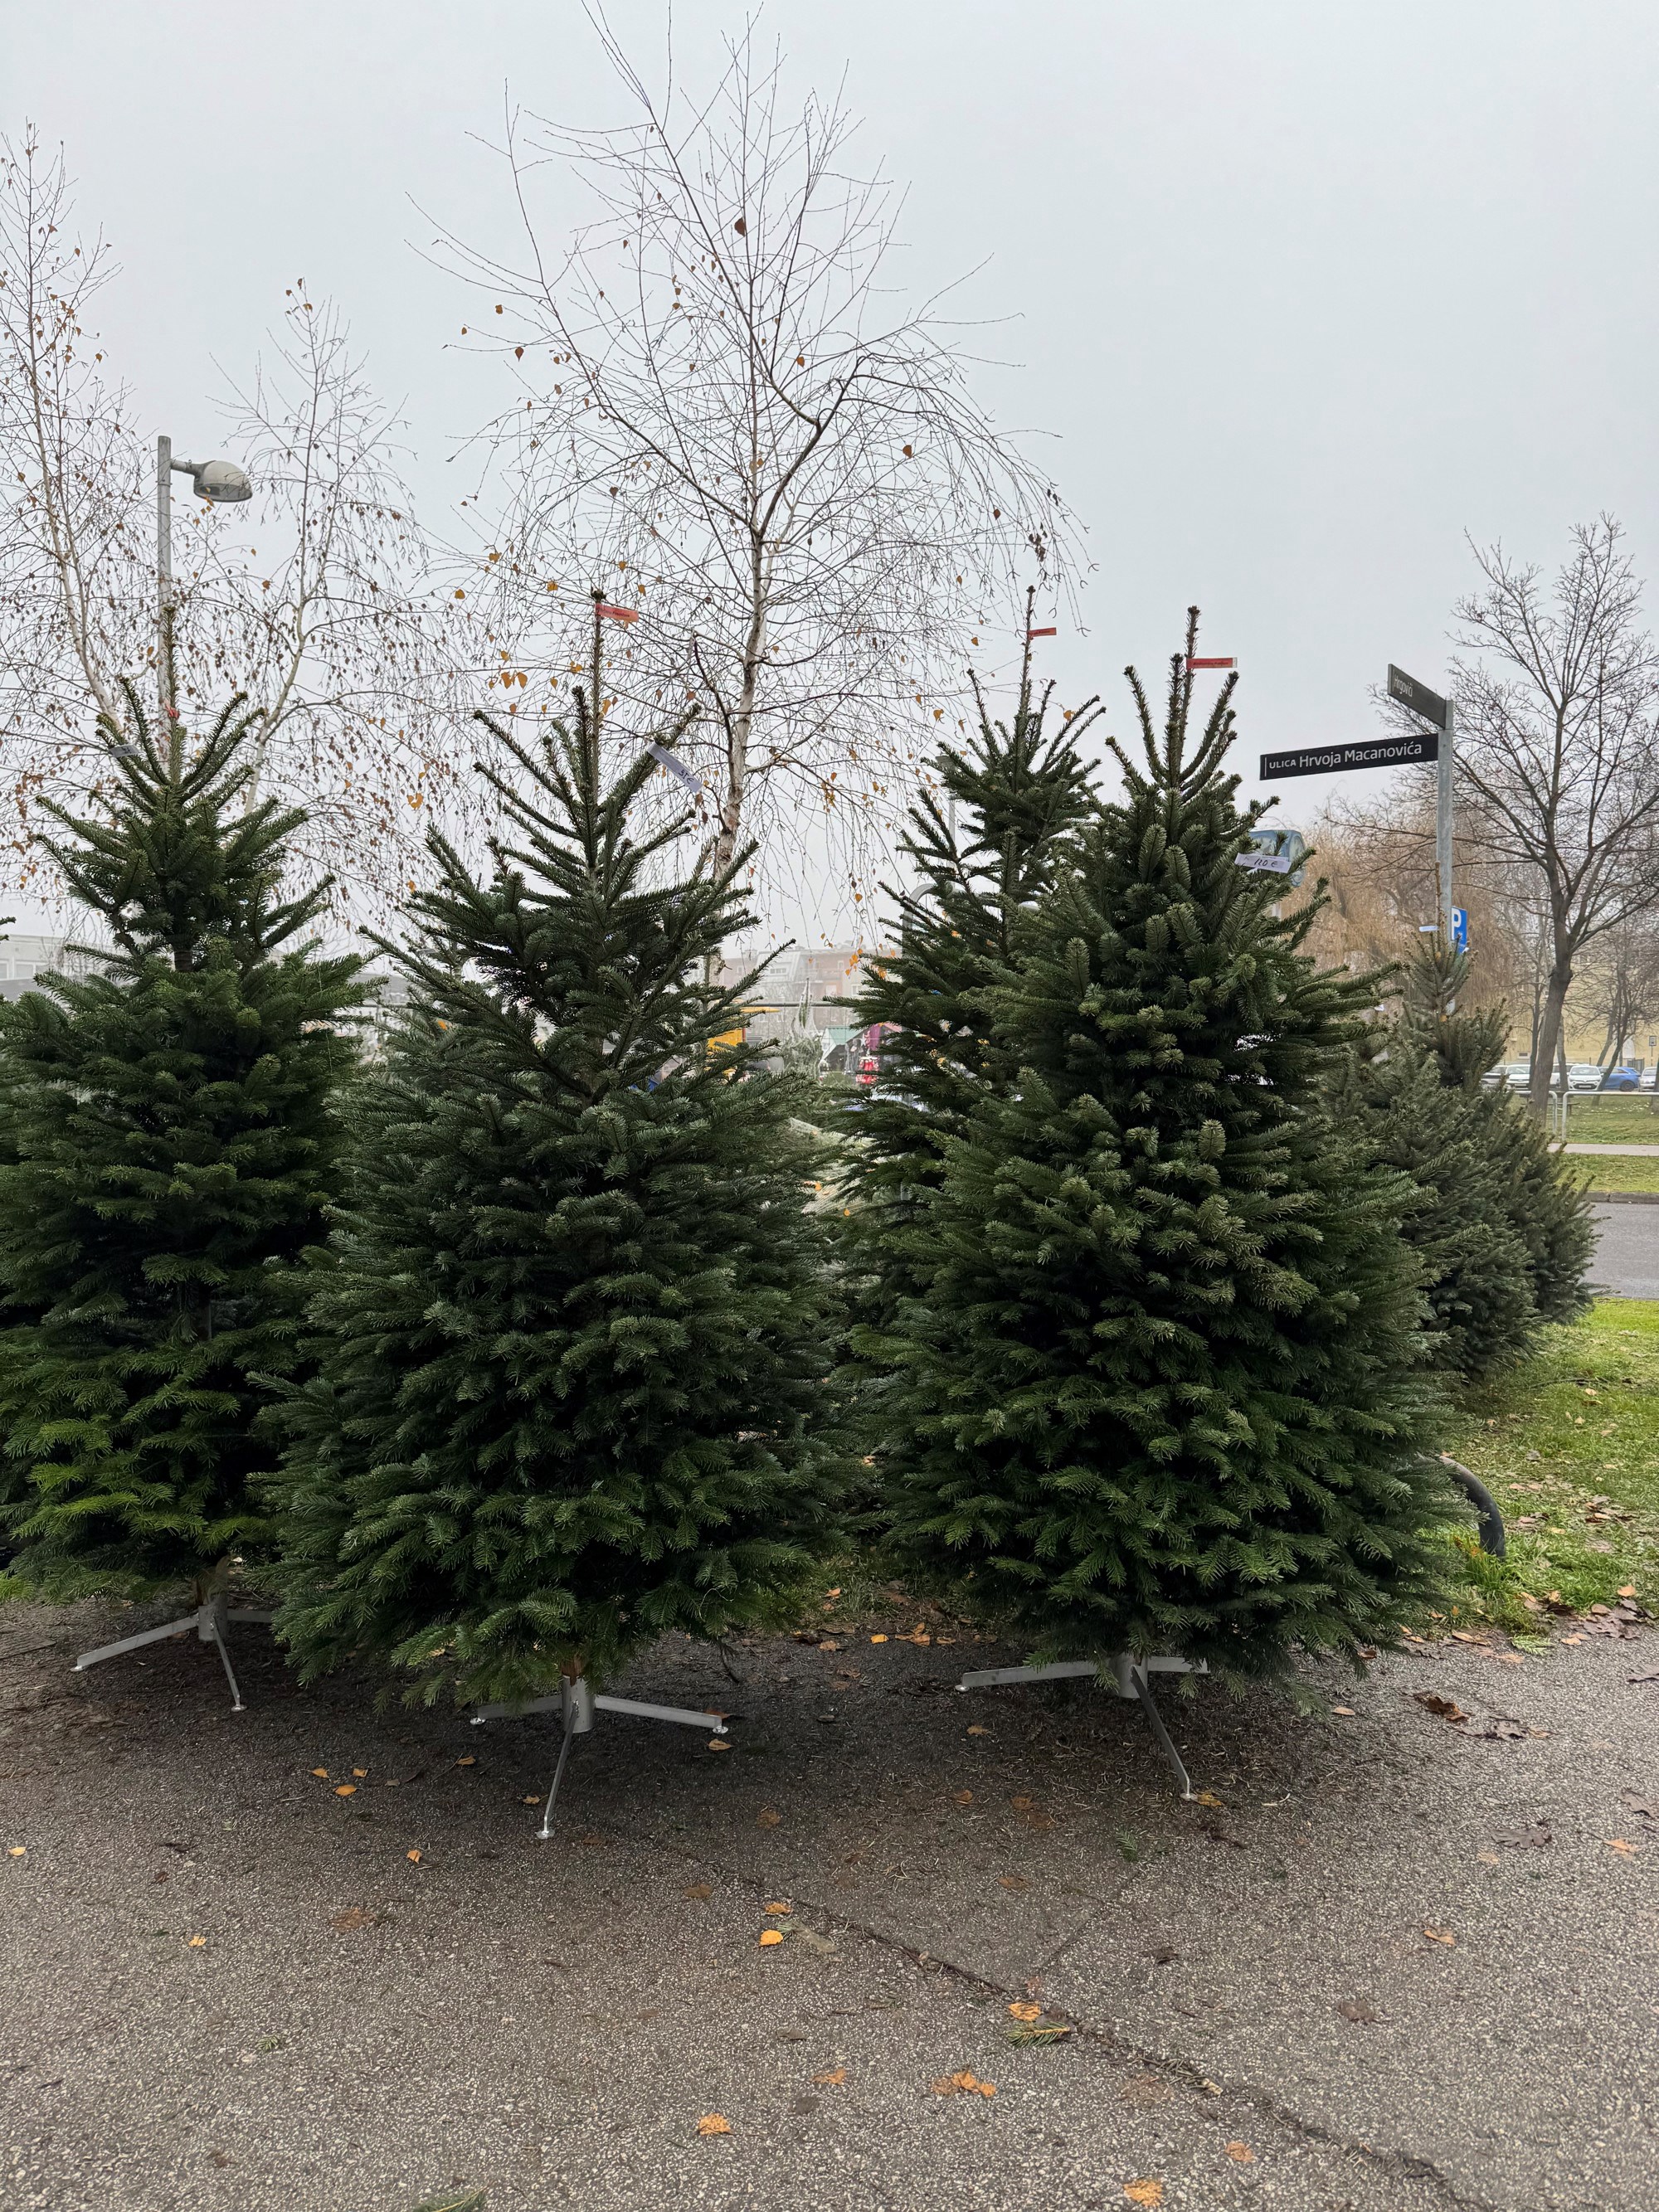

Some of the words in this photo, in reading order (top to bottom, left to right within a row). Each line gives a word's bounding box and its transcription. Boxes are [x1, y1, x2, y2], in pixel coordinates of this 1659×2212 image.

[1268, 759, 1297, 769] ULICA
[1299, 751, 1341, 768] Hrvoja
[1344, 741, 1422, 762] Macanovića
[1451, 907, 1462, 941] P
